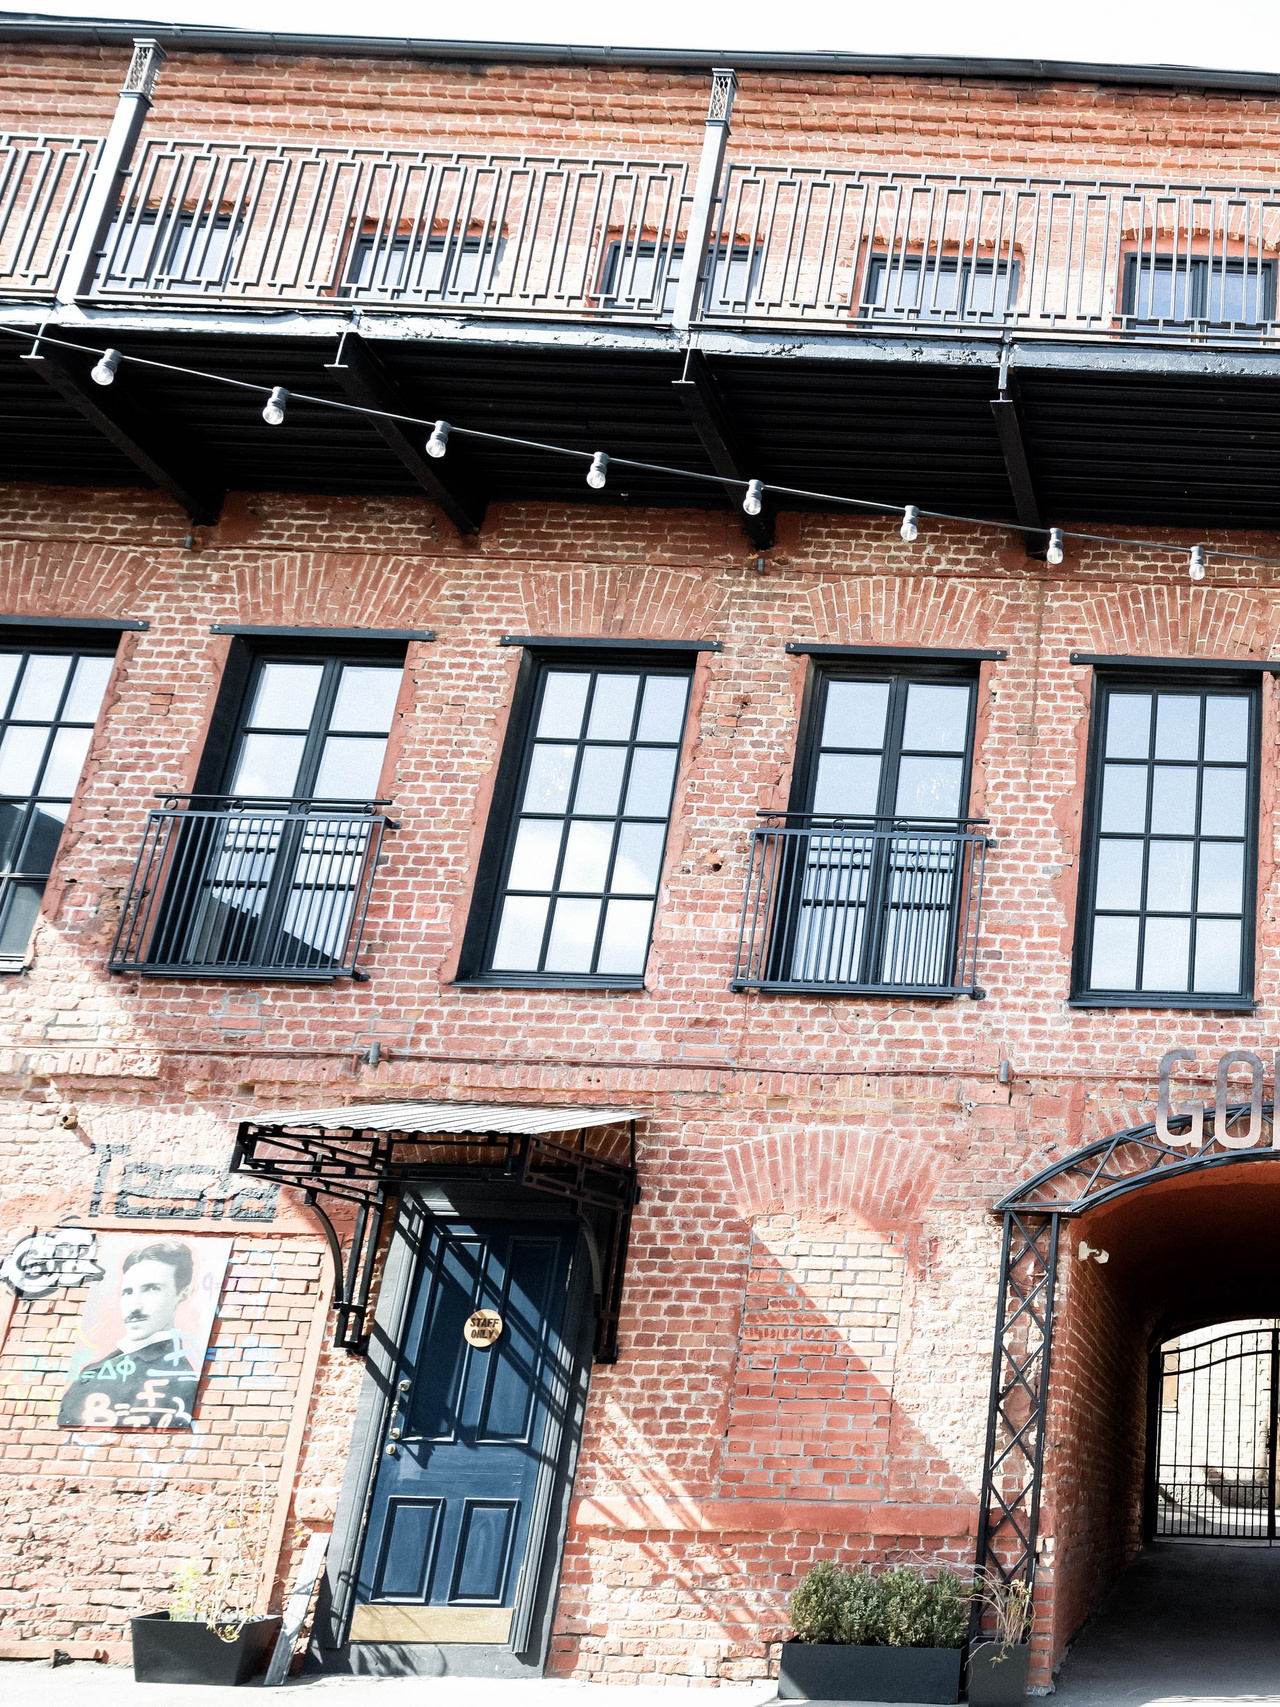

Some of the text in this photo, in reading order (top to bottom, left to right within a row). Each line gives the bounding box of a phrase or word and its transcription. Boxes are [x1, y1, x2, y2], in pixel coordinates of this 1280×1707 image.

[88, 1143, 281, 1222] Tesla
[470, 1318, 499, 1328] STAFF
[471, 1329, 495, 1339] ONLY
